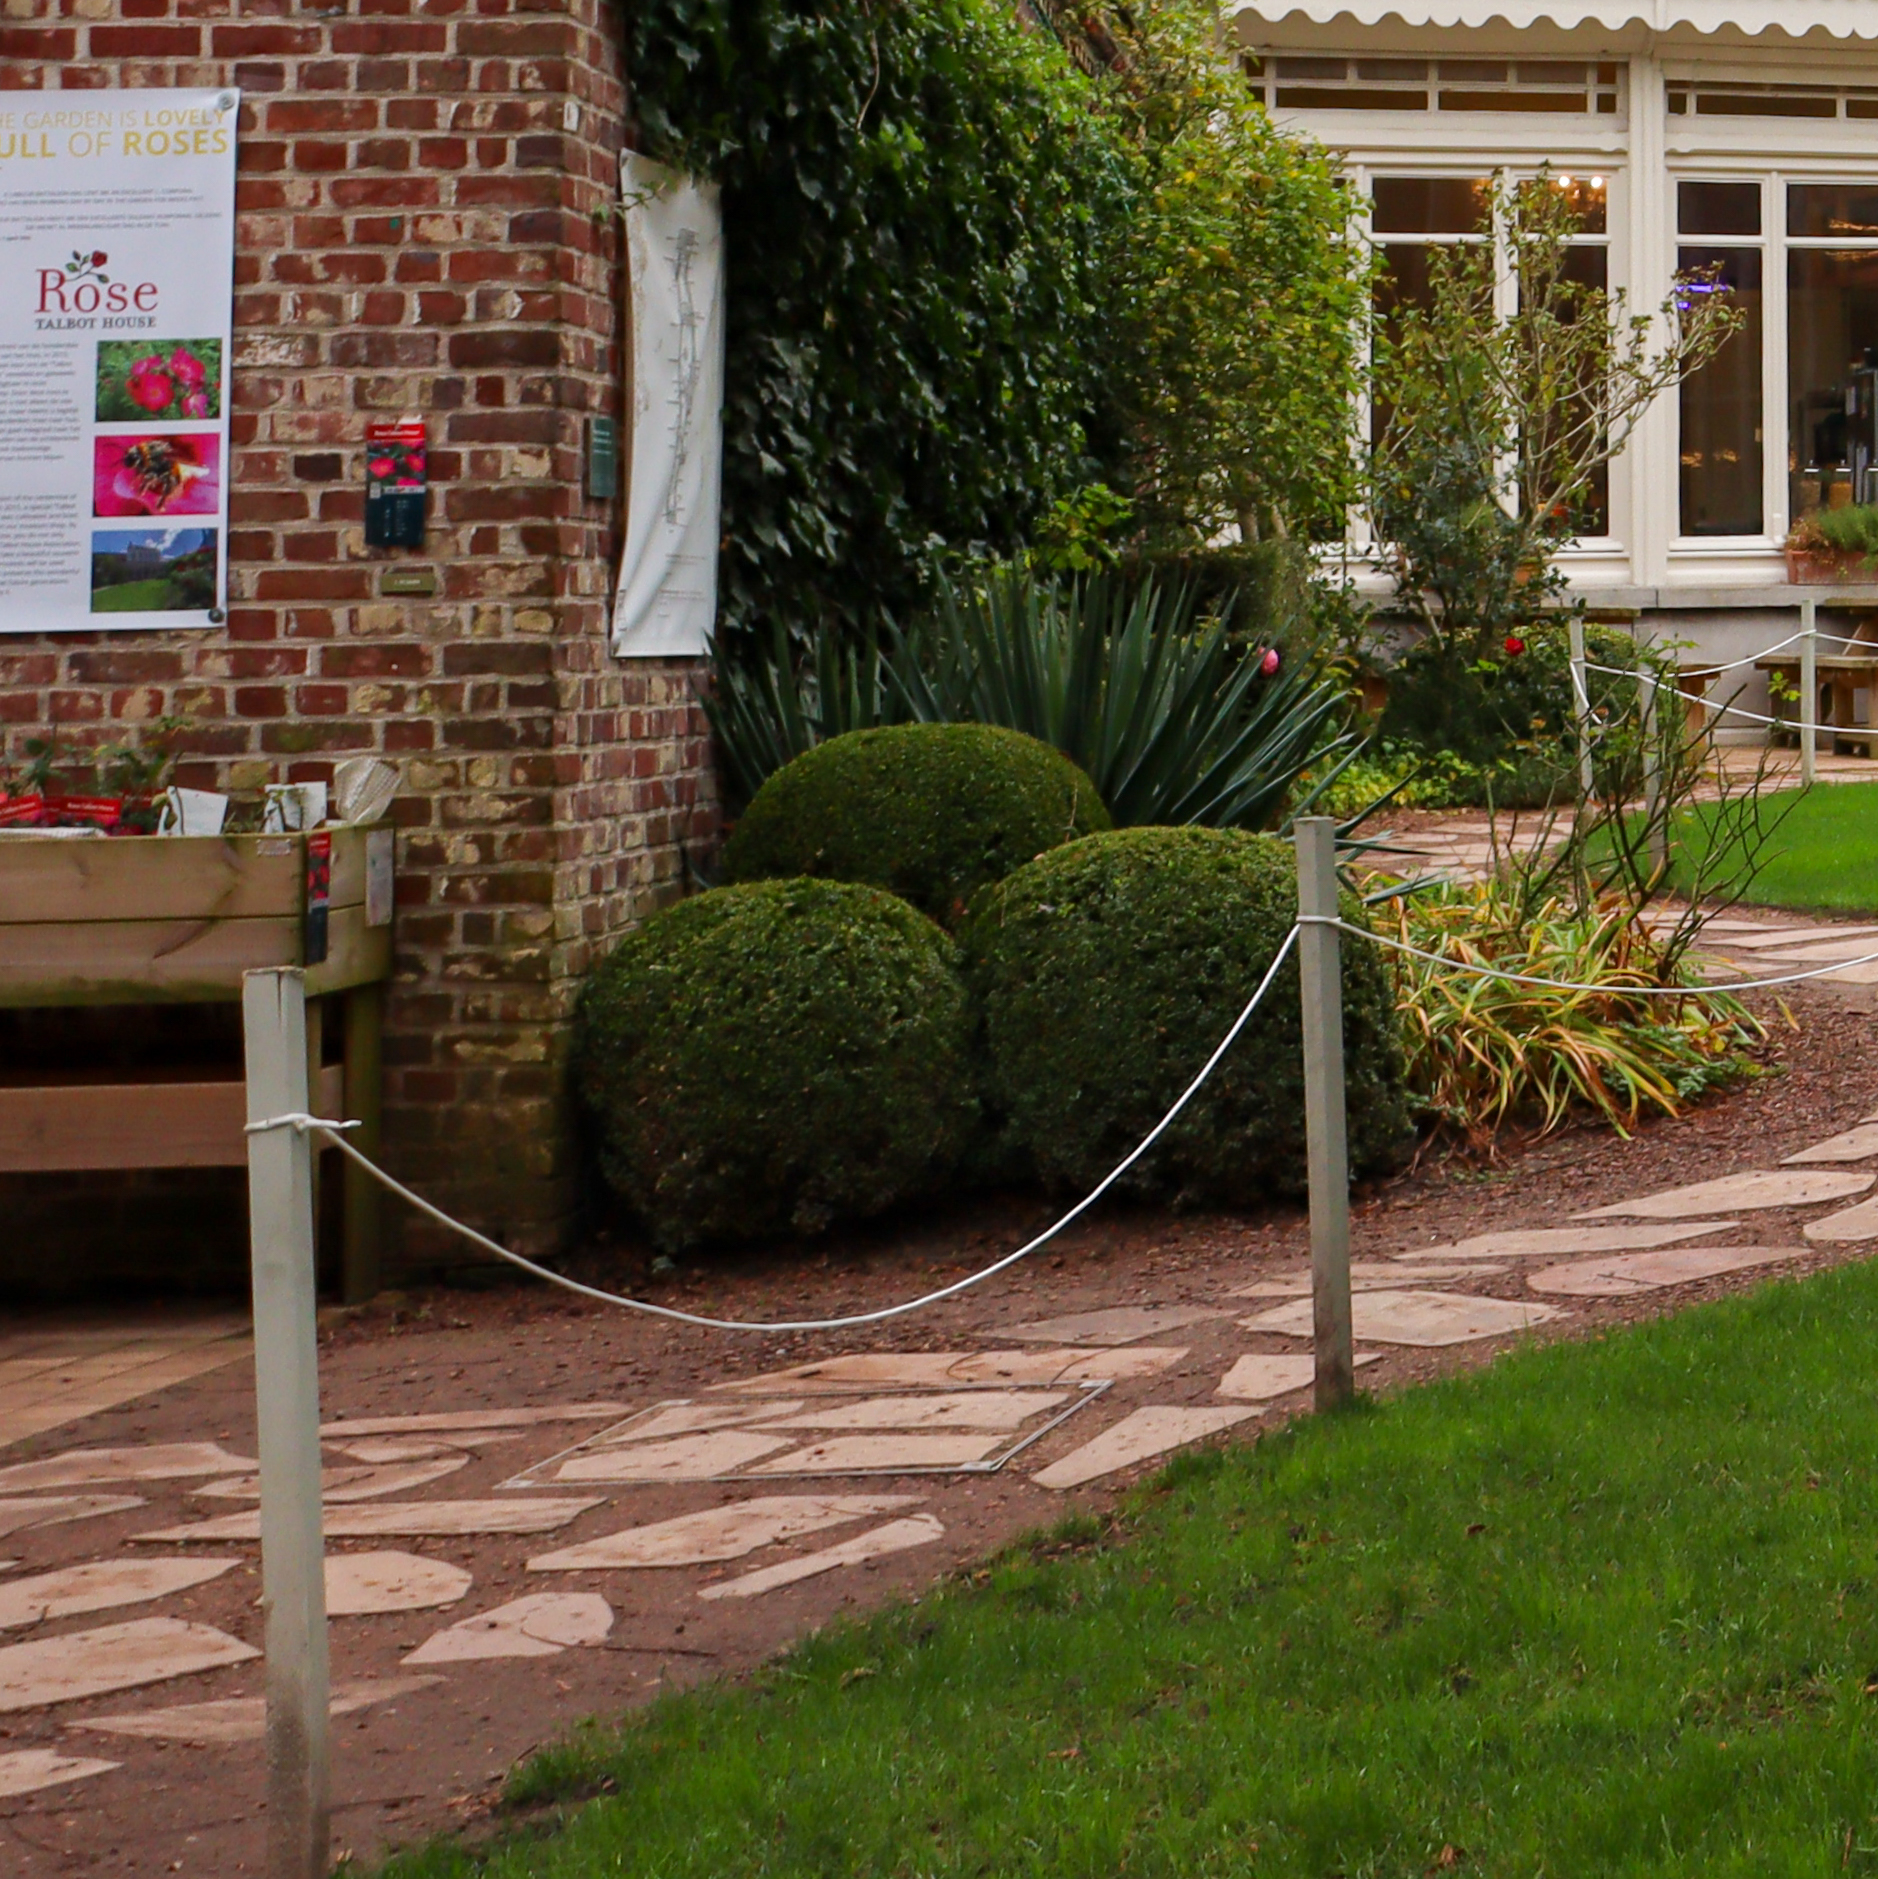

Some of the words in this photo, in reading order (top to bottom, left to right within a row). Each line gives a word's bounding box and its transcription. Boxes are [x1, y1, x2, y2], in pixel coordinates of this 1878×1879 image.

[23, 110, 113, 130] GARDEN
[120, 109, 137, 128] IS
[144, 107, 226, 127] LOVELY
[0, 133, 57, 159] ULL
[67, 131, 112, 158] OF
[123, 128, 228, 156] ROSES
[34, 268, 158, 314] Rose
[36, 317, 96, 330] TALBOT
[102, 316, 156, 329] HOUSE
